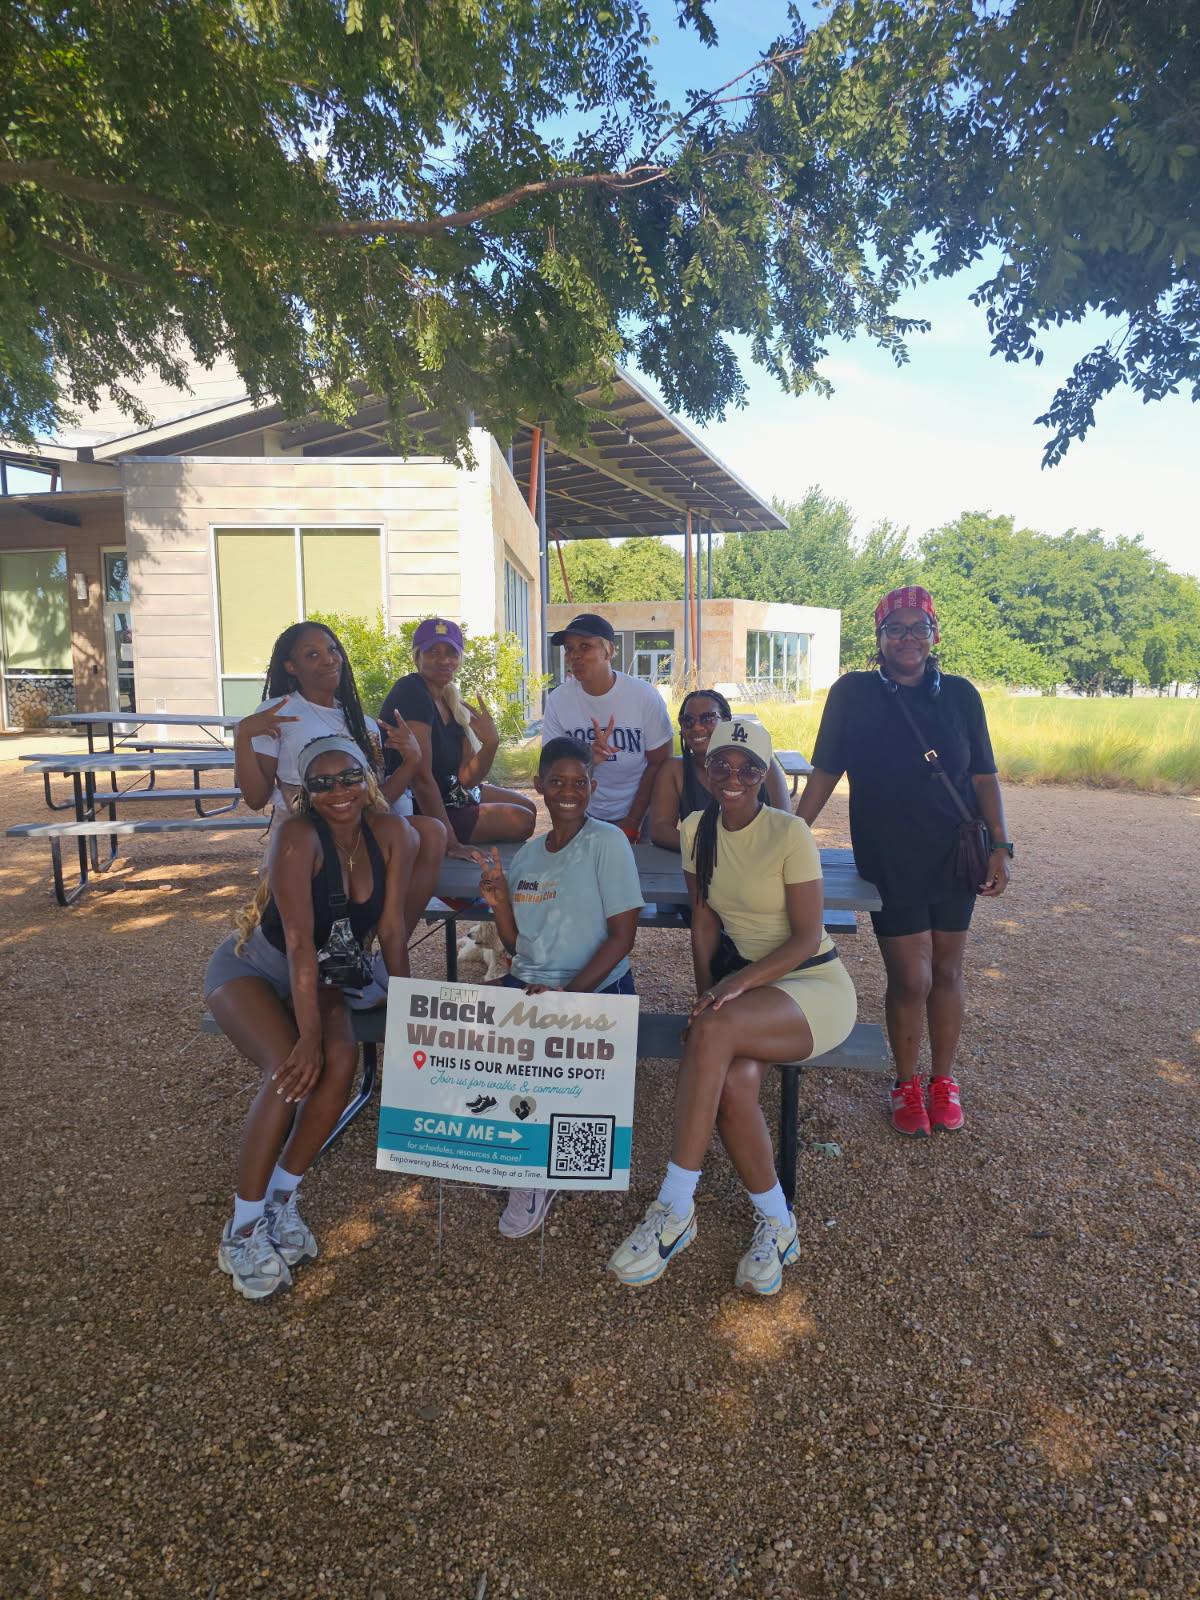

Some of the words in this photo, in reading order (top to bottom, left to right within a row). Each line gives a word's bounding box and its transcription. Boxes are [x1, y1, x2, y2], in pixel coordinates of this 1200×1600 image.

[731, 723, 748, 743] LA
[440, 987, 478, 1003] DFW
[410, 994, 495, 1025] Black
[498, 1001, 617, 1031] Moms
[407, 1023, 535, 1062] Walking
[545, 1036, 615, 1061] Club
[430, 1055, 457, 1069] THIS
[460, 1058, 471, 1071] IS
[474, 1061, 502, 1074] OUR
[506, 1063, 564, 1078] MEETING
[567, 1067, 605, 1080] SPOT!
[430, 1069, 455, 1085] Join
[456, 1078, 467, 1086] us
[466, 1076, 485, 1089] for
[486, 1079, 516, 1091] walks
[519, 1080, 530, 1093] &
[532, 1083, 583, 1098] community
[413, 1117, 463, 1137] SCAN
[466, 1124, 495, 1141] ME
[407, 1140, 417, 1149] for
[456, 1148, 491, 1159] resources
[491, 1151, 498, 1159] &
[499, 1154, 522, 1162] more!
[389, 1153, 431, 1168] Empowering
[432, 1160, 450, 1169] Black
[475, 1165, 491, 1174] One
[492, 1167, 507, 1179] Step
[508, 1170, 518, 1178] at
[524, 1170, 543, 1179] Time.
